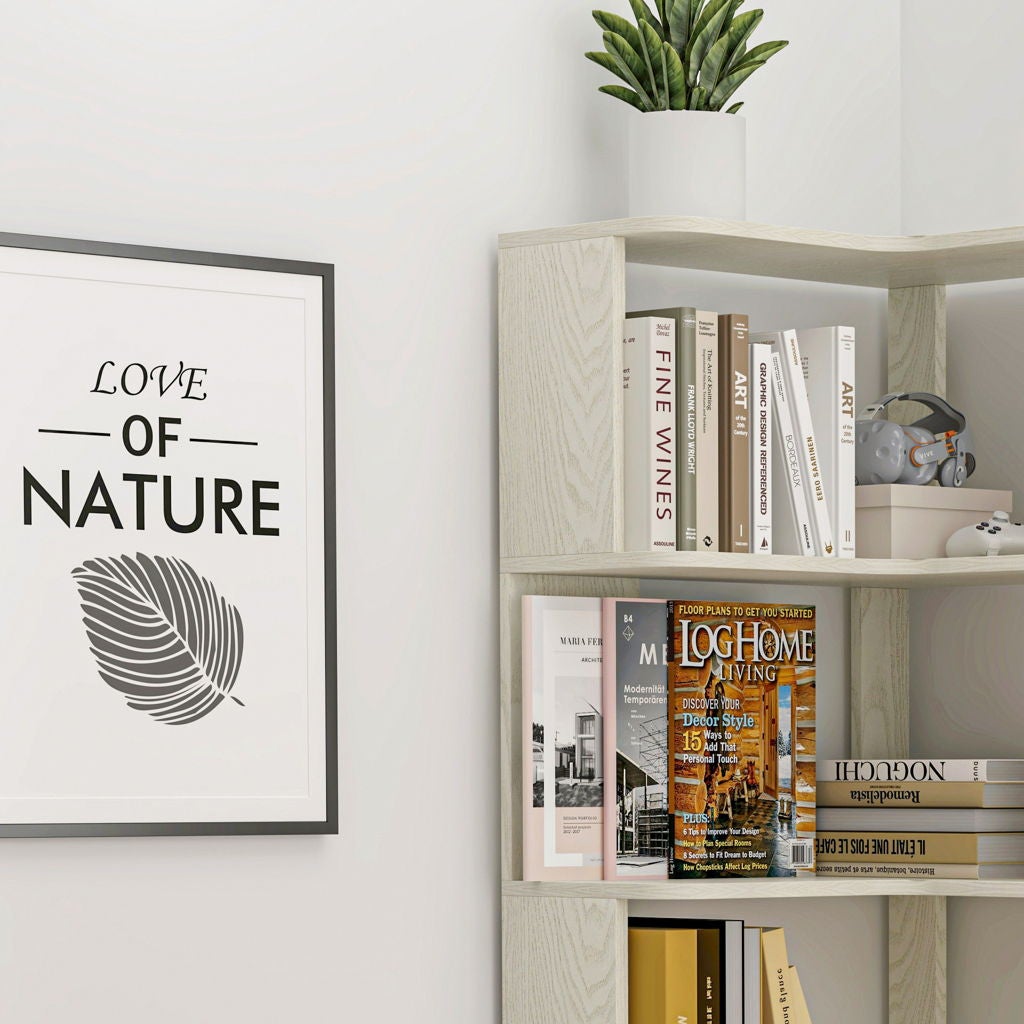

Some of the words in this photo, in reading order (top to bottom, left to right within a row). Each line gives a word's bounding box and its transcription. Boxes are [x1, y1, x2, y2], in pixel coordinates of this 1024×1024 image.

[90, 360, 208, 402] LOVE
[656, 350, 671, 412] FINE
[122, 414, 182, 458] OF
[656, 427, 672, 520] WINES
[23, 465, 280, 537] NATURE
[623, 614, 633, 623] 84
[679, 605, 704, 615] FLOOR
[706, 606, 731, 616] PLANS
[733, 607, 743, 617] TO
[745, 607, 760, 617] GET
[763, 607, 778, 618] YOU
[780, 608, 813, 619] STARTED
[560, 636, 585, 646] MARIA
[719, 664, 777, 682] LIVING
[623, 684, 665, 694] Modernität
[683, 698, 719, 709] DISCOVER
[721, 698, 740, 710] YOUR
[683, 713, 720, 727] Decor
[722, 713, 755, 731] Style
[682, 730, 702, 751] 15
[704, 730, 723, 740] Ways
[725, 730, 732, 740] to
[704, 742, 718, 751] Add
[720, 742, 736, 752] That
[683, 754, 715, 764] Personal
[717, 754, 738, 764] Touch
[835, 761, 946, 781] NOGUCHI
[850, 790, 921, 804] Remodelista
[682, 813, 710, 824] PLUS:
[688, 828, 699, 836] Tips
[707, 828, 728, 836] Improve
[742, 828, 760, 837] Design
[715, 839, 733, 848] Special
[734, 839, 752, 847] Rooms
[688, 851, 708, 859] Secrets
[724, 851, 741, 859] Dream
[749, 851, 767, 859] Budget
